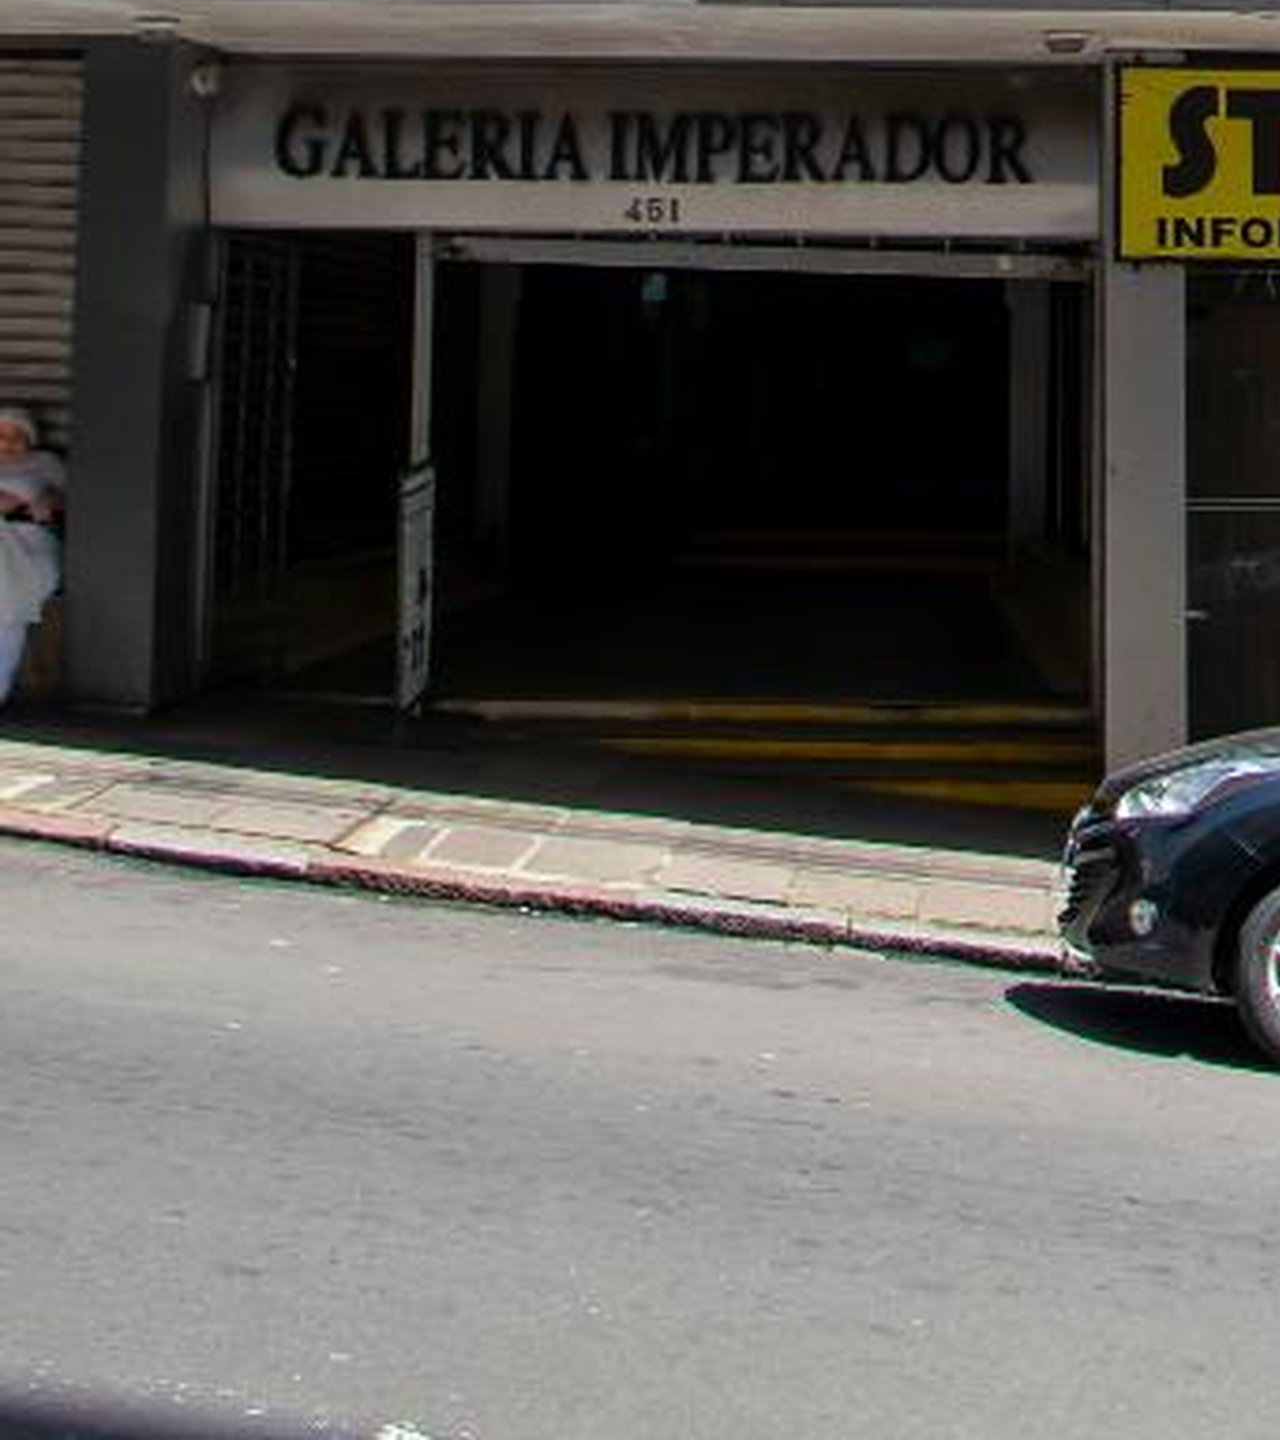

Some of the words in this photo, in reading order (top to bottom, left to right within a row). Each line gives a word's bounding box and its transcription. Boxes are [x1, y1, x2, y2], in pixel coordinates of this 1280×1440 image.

[274, 103, 593, 182] GALERIA
[603, 108, 1037, 186] IMPERADOR
[624, 196, 683, 225] 451
